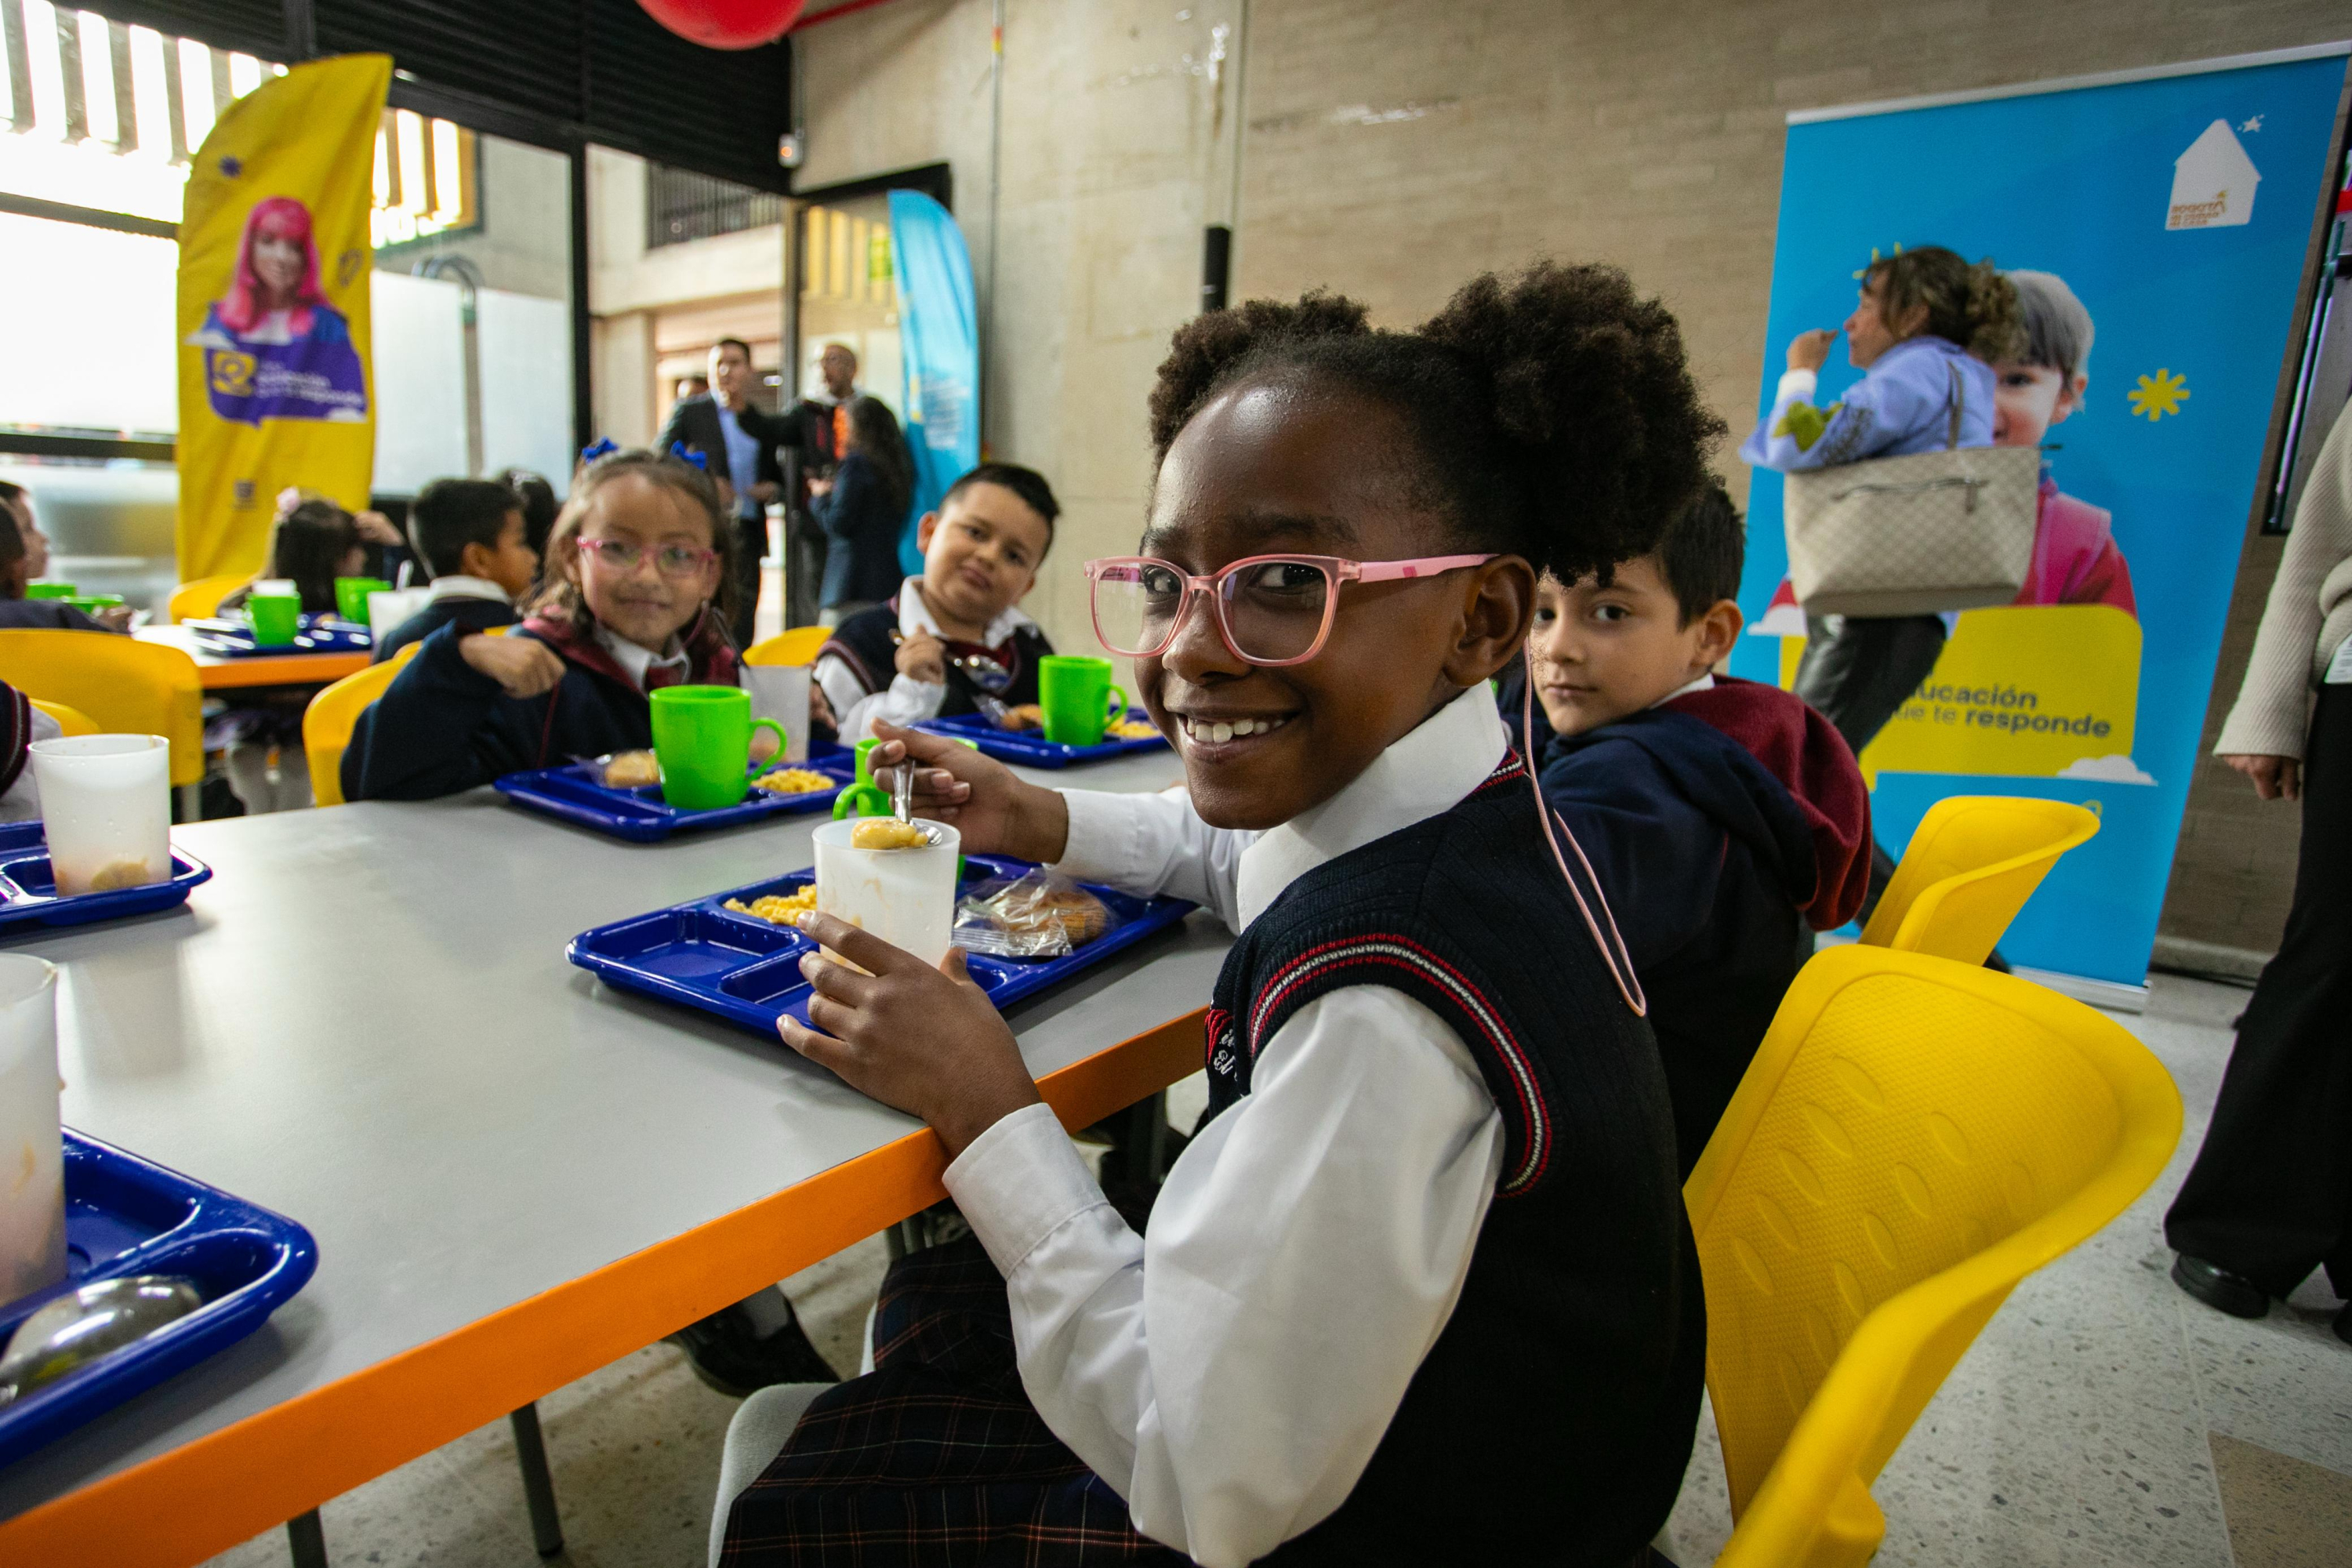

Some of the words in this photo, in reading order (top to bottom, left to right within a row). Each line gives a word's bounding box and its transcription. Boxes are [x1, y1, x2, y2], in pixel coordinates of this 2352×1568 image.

[1911, 683, 2037, 710] ucación
[1891, 705, 1925, 722] ue
[1933, 705, 1957, 724] te
[1965, 710, 2111, 739] responde
